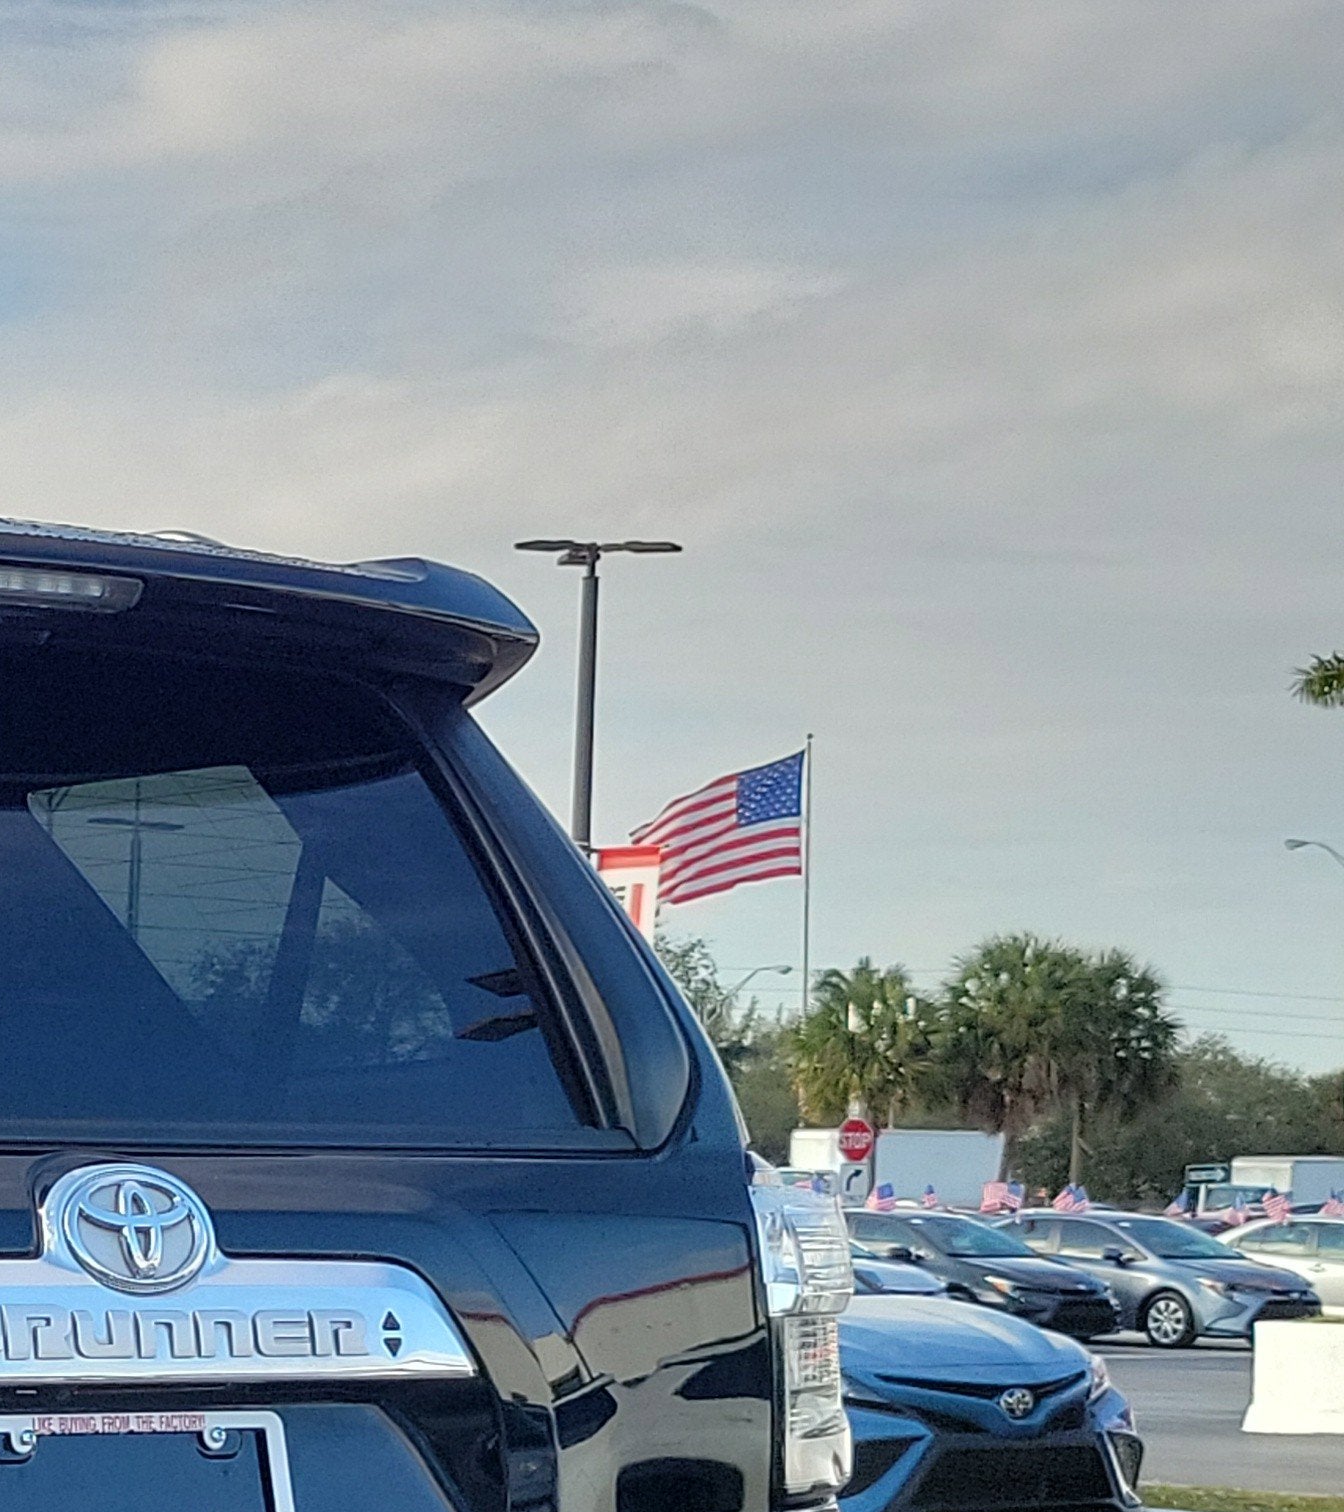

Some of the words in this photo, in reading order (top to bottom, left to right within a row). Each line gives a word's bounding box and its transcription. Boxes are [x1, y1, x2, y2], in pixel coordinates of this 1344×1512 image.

[840, 1132, 871, 1149] STOP
[32, 1417, 53, 1432] LIKE
[59, 1416, 96, 1432] BUYING
[102, 1415, 130, 1432] FROM
[136, 1414, 155, 1430] THE
